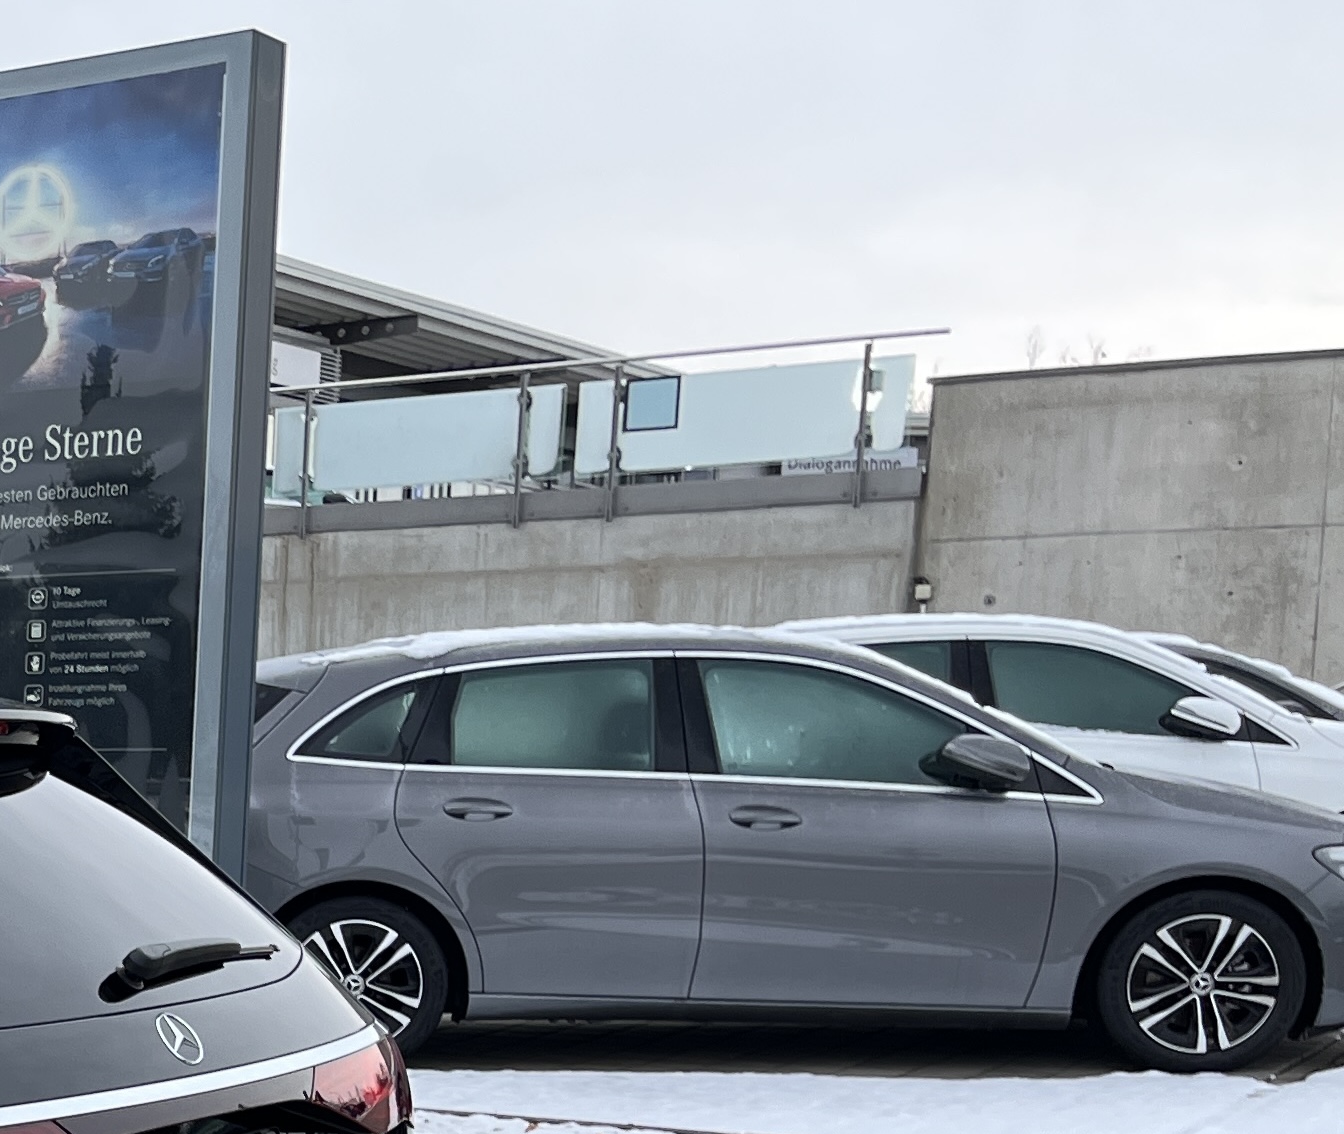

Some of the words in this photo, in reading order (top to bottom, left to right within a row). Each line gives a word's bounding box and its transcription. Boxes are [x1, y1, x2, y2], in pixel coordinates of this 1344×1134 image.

[44, 423, 143, 462] Sterne
[36, 481, 129, 502] Gebrauchten
[0, 509, 113, 531] Mercedes-Benz.
[63, 585, 81, 597] Tage
[49, 666, 63, 674] von
[64, 664, 75, 674] 24
[75, 663, 109, 674] Stunden
